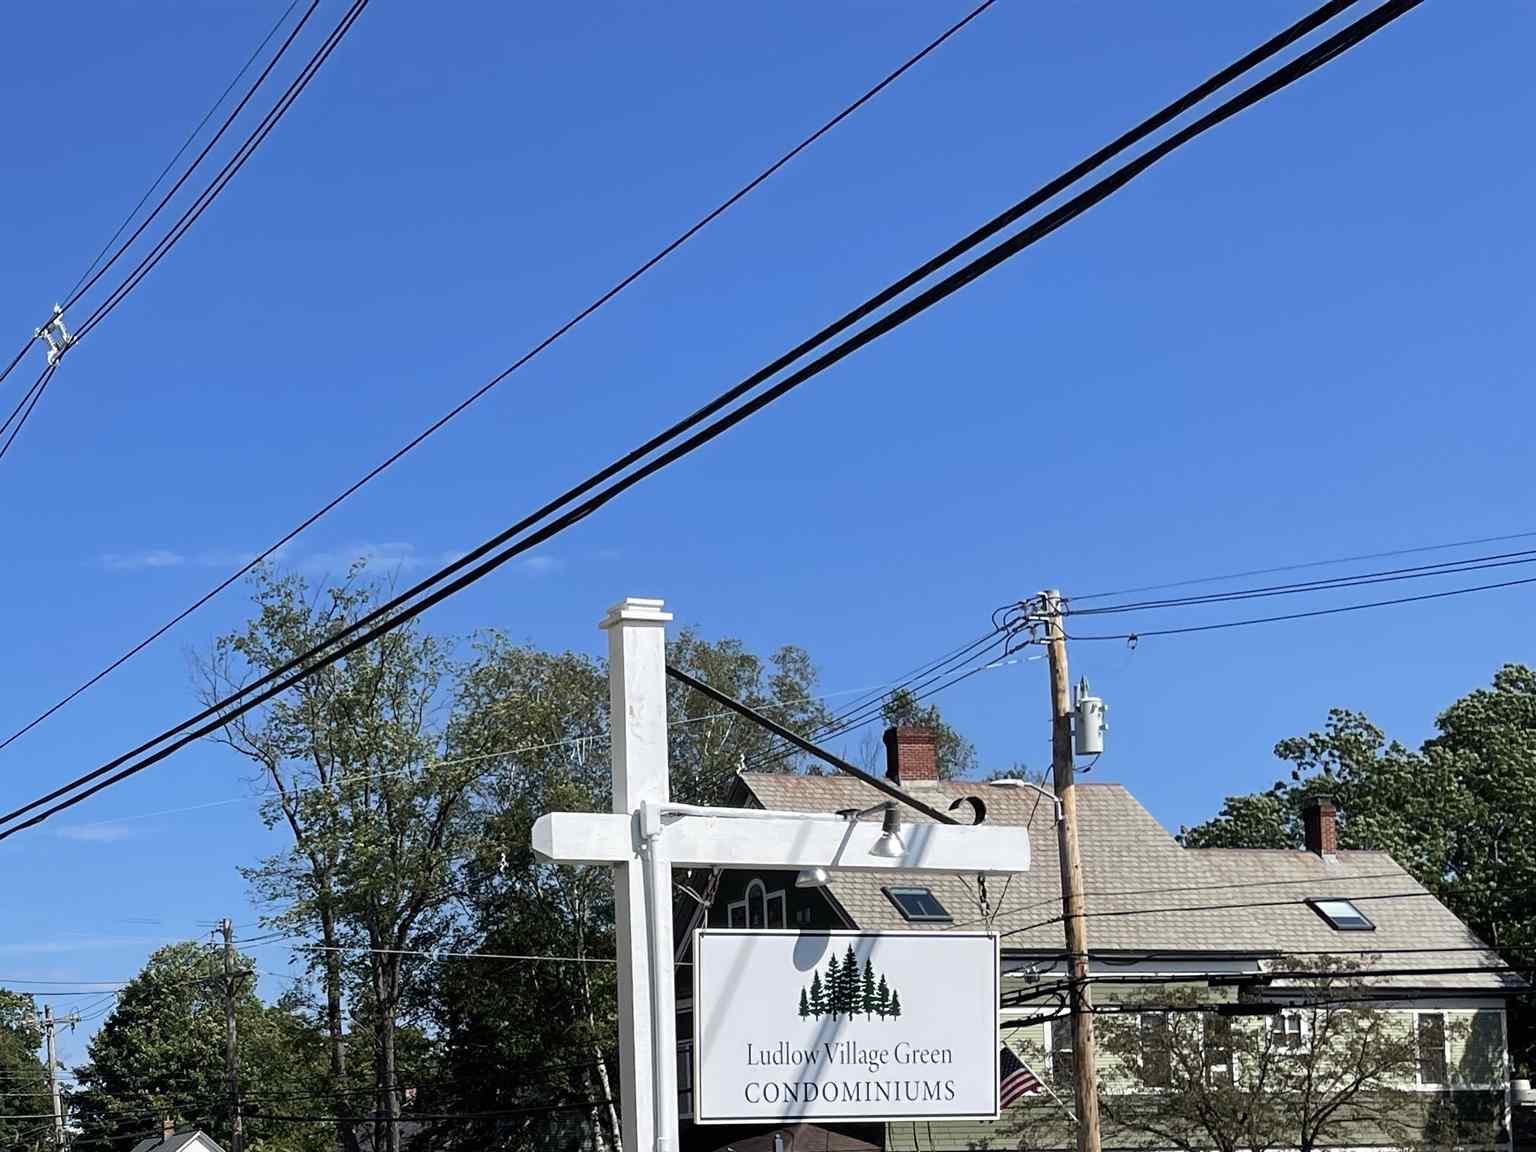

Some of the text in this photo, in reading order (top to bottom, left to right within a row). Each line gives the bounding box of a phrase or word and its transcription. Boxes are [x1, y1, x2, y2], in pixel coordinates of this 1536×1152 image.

[747, 1041, 953, 1073] Ludlow Village Green
[745, 1080, 955, 1103] CONDOMINIUMS
